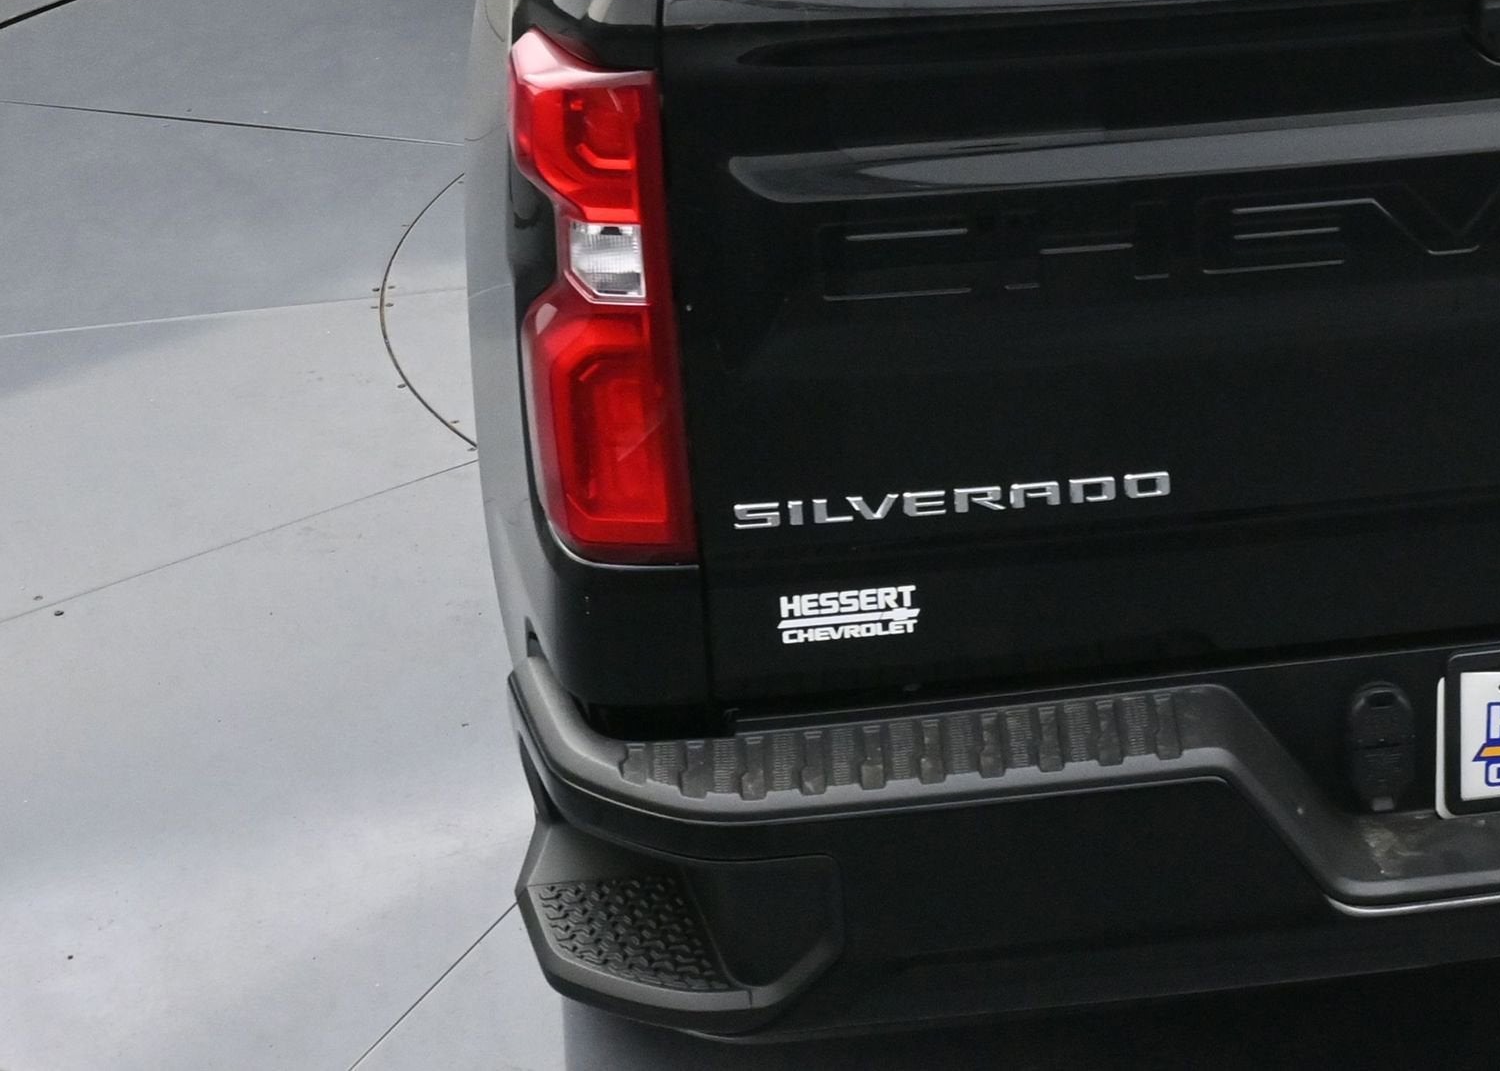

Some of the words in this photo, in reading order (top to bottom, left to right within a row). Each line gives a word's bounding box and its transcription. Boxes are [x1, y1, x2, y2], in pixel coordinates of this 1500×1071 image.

[733, 470, 1171, 530] SILVERADO
[779, 584, 916, 618] HESSERT
[782, 618, 919, 644] CHEVROLET
